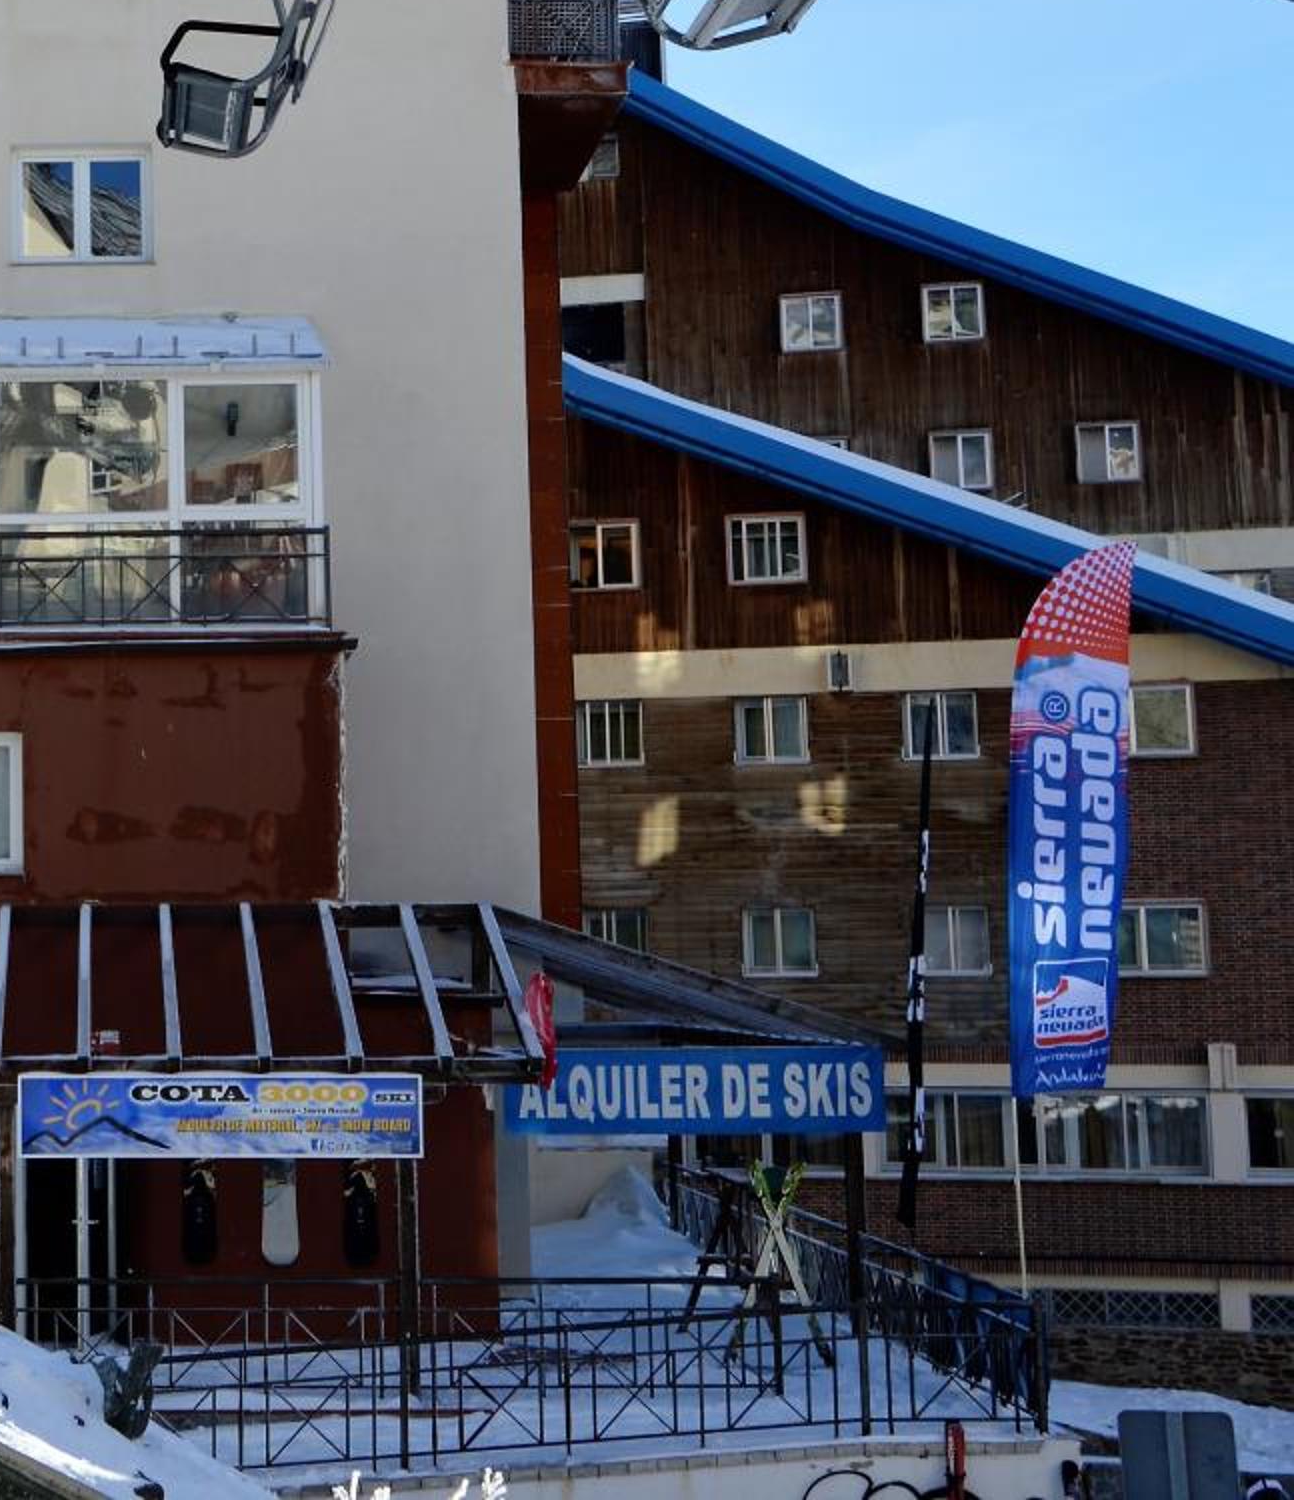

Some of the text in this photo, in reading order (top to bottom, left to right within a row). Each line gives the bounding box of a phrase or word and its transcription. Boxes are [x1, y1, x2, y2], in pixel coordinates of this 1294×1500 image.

[1017, 735, 1067, 948] sierra
[1039, 1003, 1097, 1020] sierra
[131, 1085, 250, 1103] COTA
[258, 1084, 366, 1103] 3000
[518, 1061, 873, 1124] ALQUILER DE SKIS
